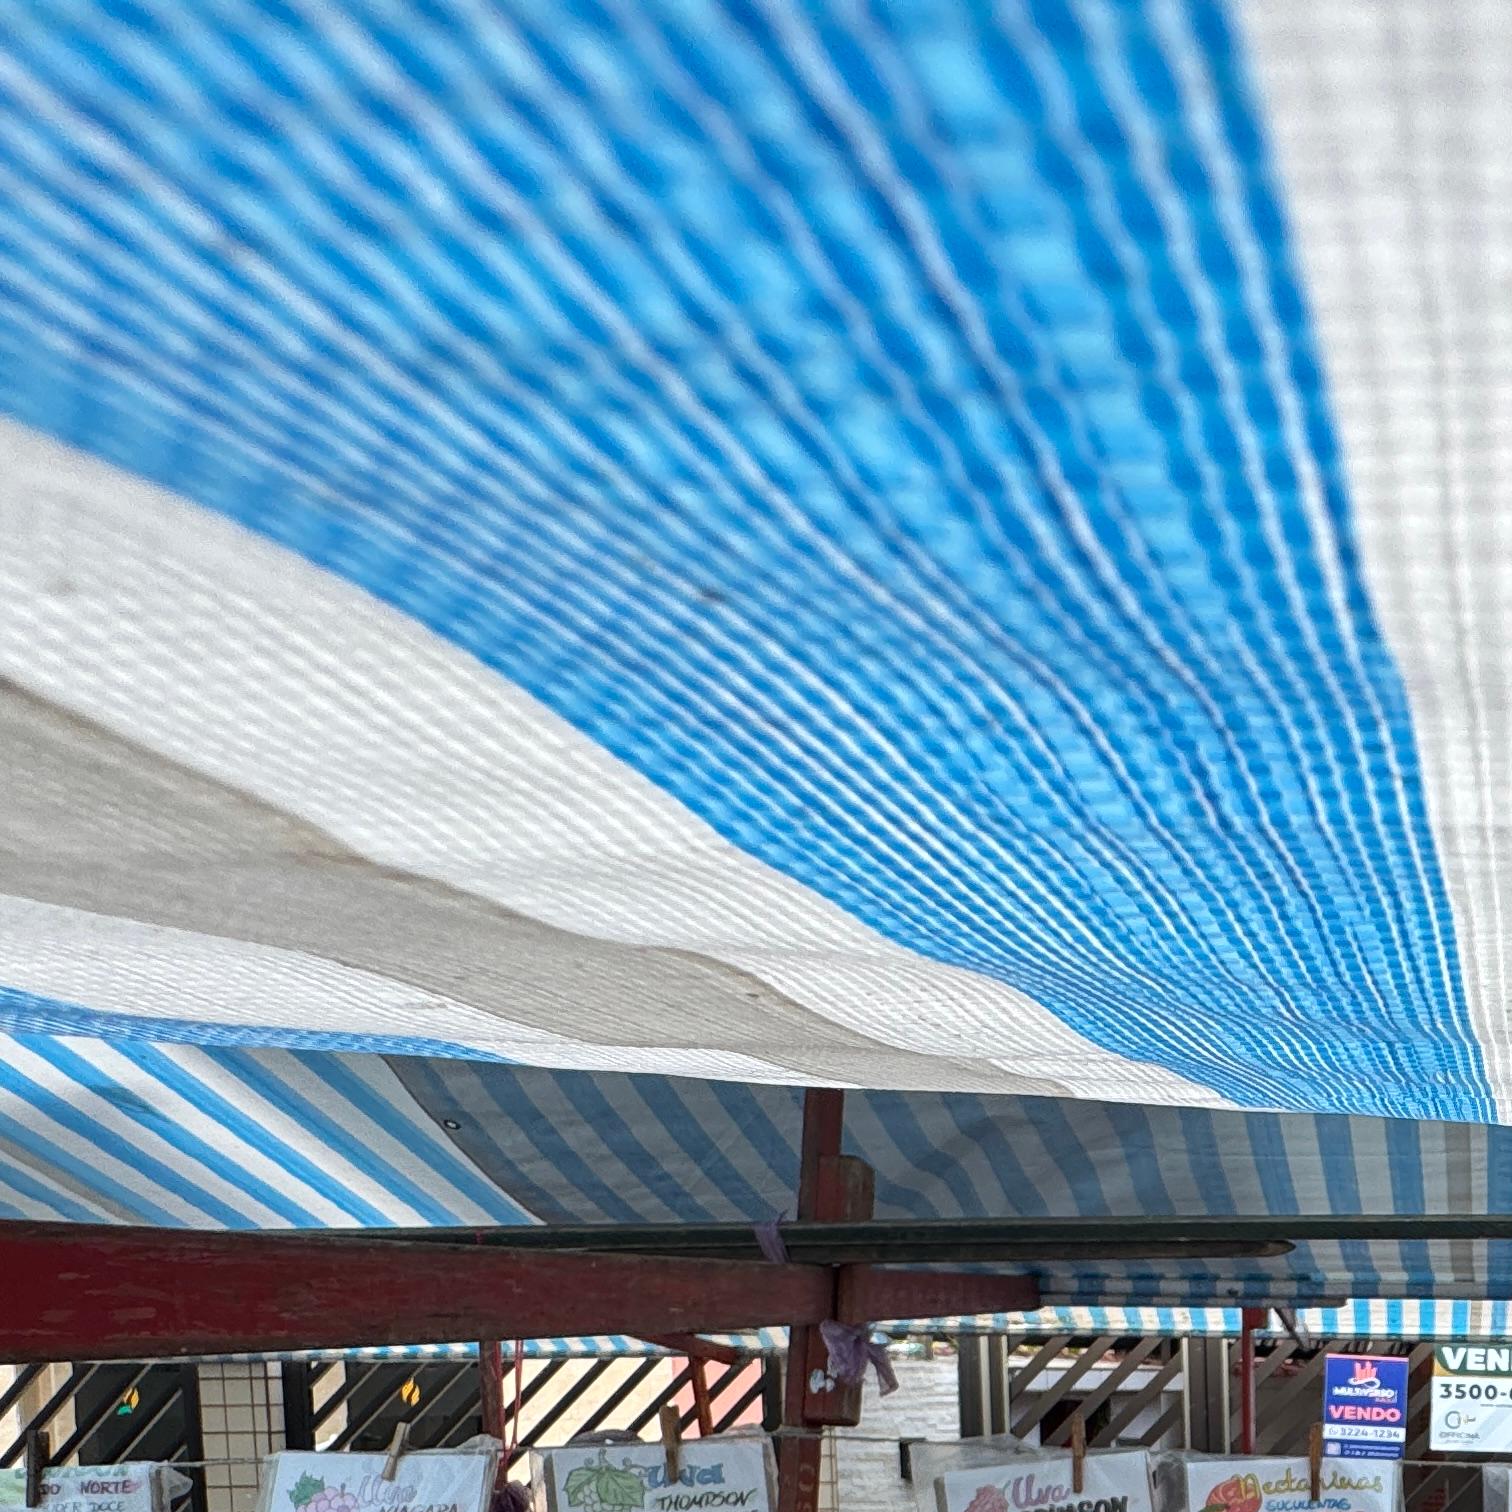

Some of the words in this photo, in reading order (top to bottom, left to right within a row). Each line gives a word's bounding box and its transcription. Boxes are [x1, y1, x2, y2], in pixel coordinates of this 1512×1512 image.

[1329, 1405, 1401, 1422] VENDO
[81, 1480, 131, 1495] NORTE
[1012, 1473, 1071, 1509] Uva
[90, 1502, 124, 1512] DOCE
[656, 1488, 758, 1512] THOMPSON
